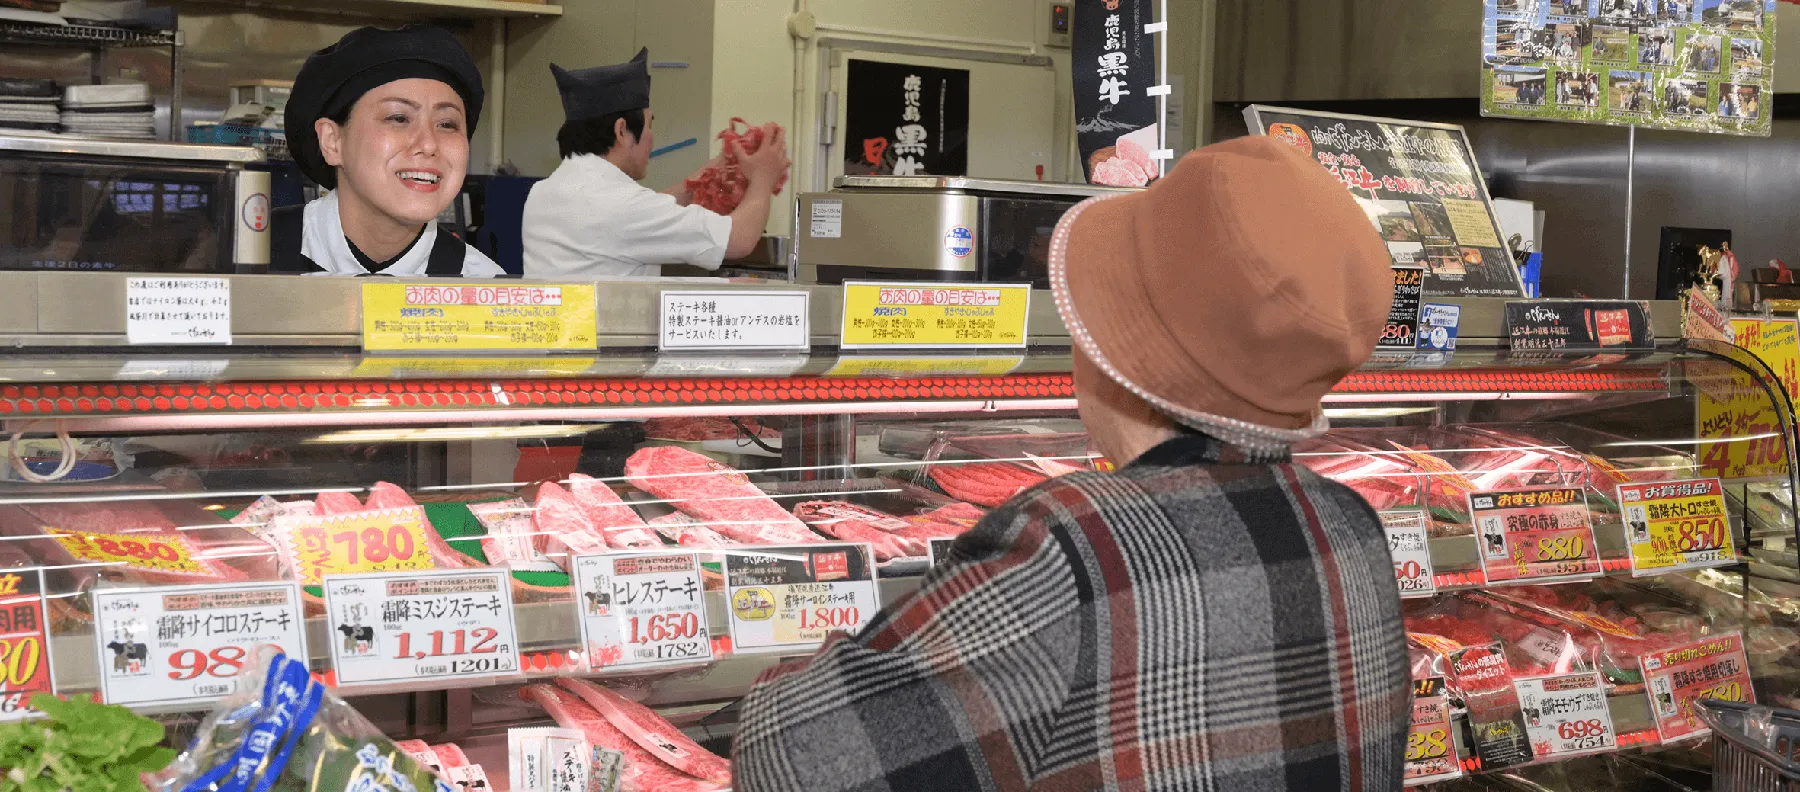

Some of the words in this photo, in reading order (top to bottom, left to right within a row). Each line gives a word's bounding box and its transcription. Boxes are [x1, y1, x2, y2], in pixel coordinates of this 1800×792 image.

[1097, 14, 1130, 105] 鹿児島黒牛
[669, 300, 717, 313] ステーキ各種
[1498, 490, 1575, 507] おすすめ品!!
[1645, 482, 1713, 498] お買得品!
[1649, 502, 1697, 519] 霜降大トロ
[1507, 512, 1559, 532] 究極の赤身
[612, 577, 697, 605] ヒレステーキ
[784, 591, 856, 608] 霜降サーロインステーキ用
[381, 595, 502, 623] 霜降ミスジステーキ
[156, 610, 291, 641] 霜降サイコロステーキ
[167, 644, 286, 681] 98
